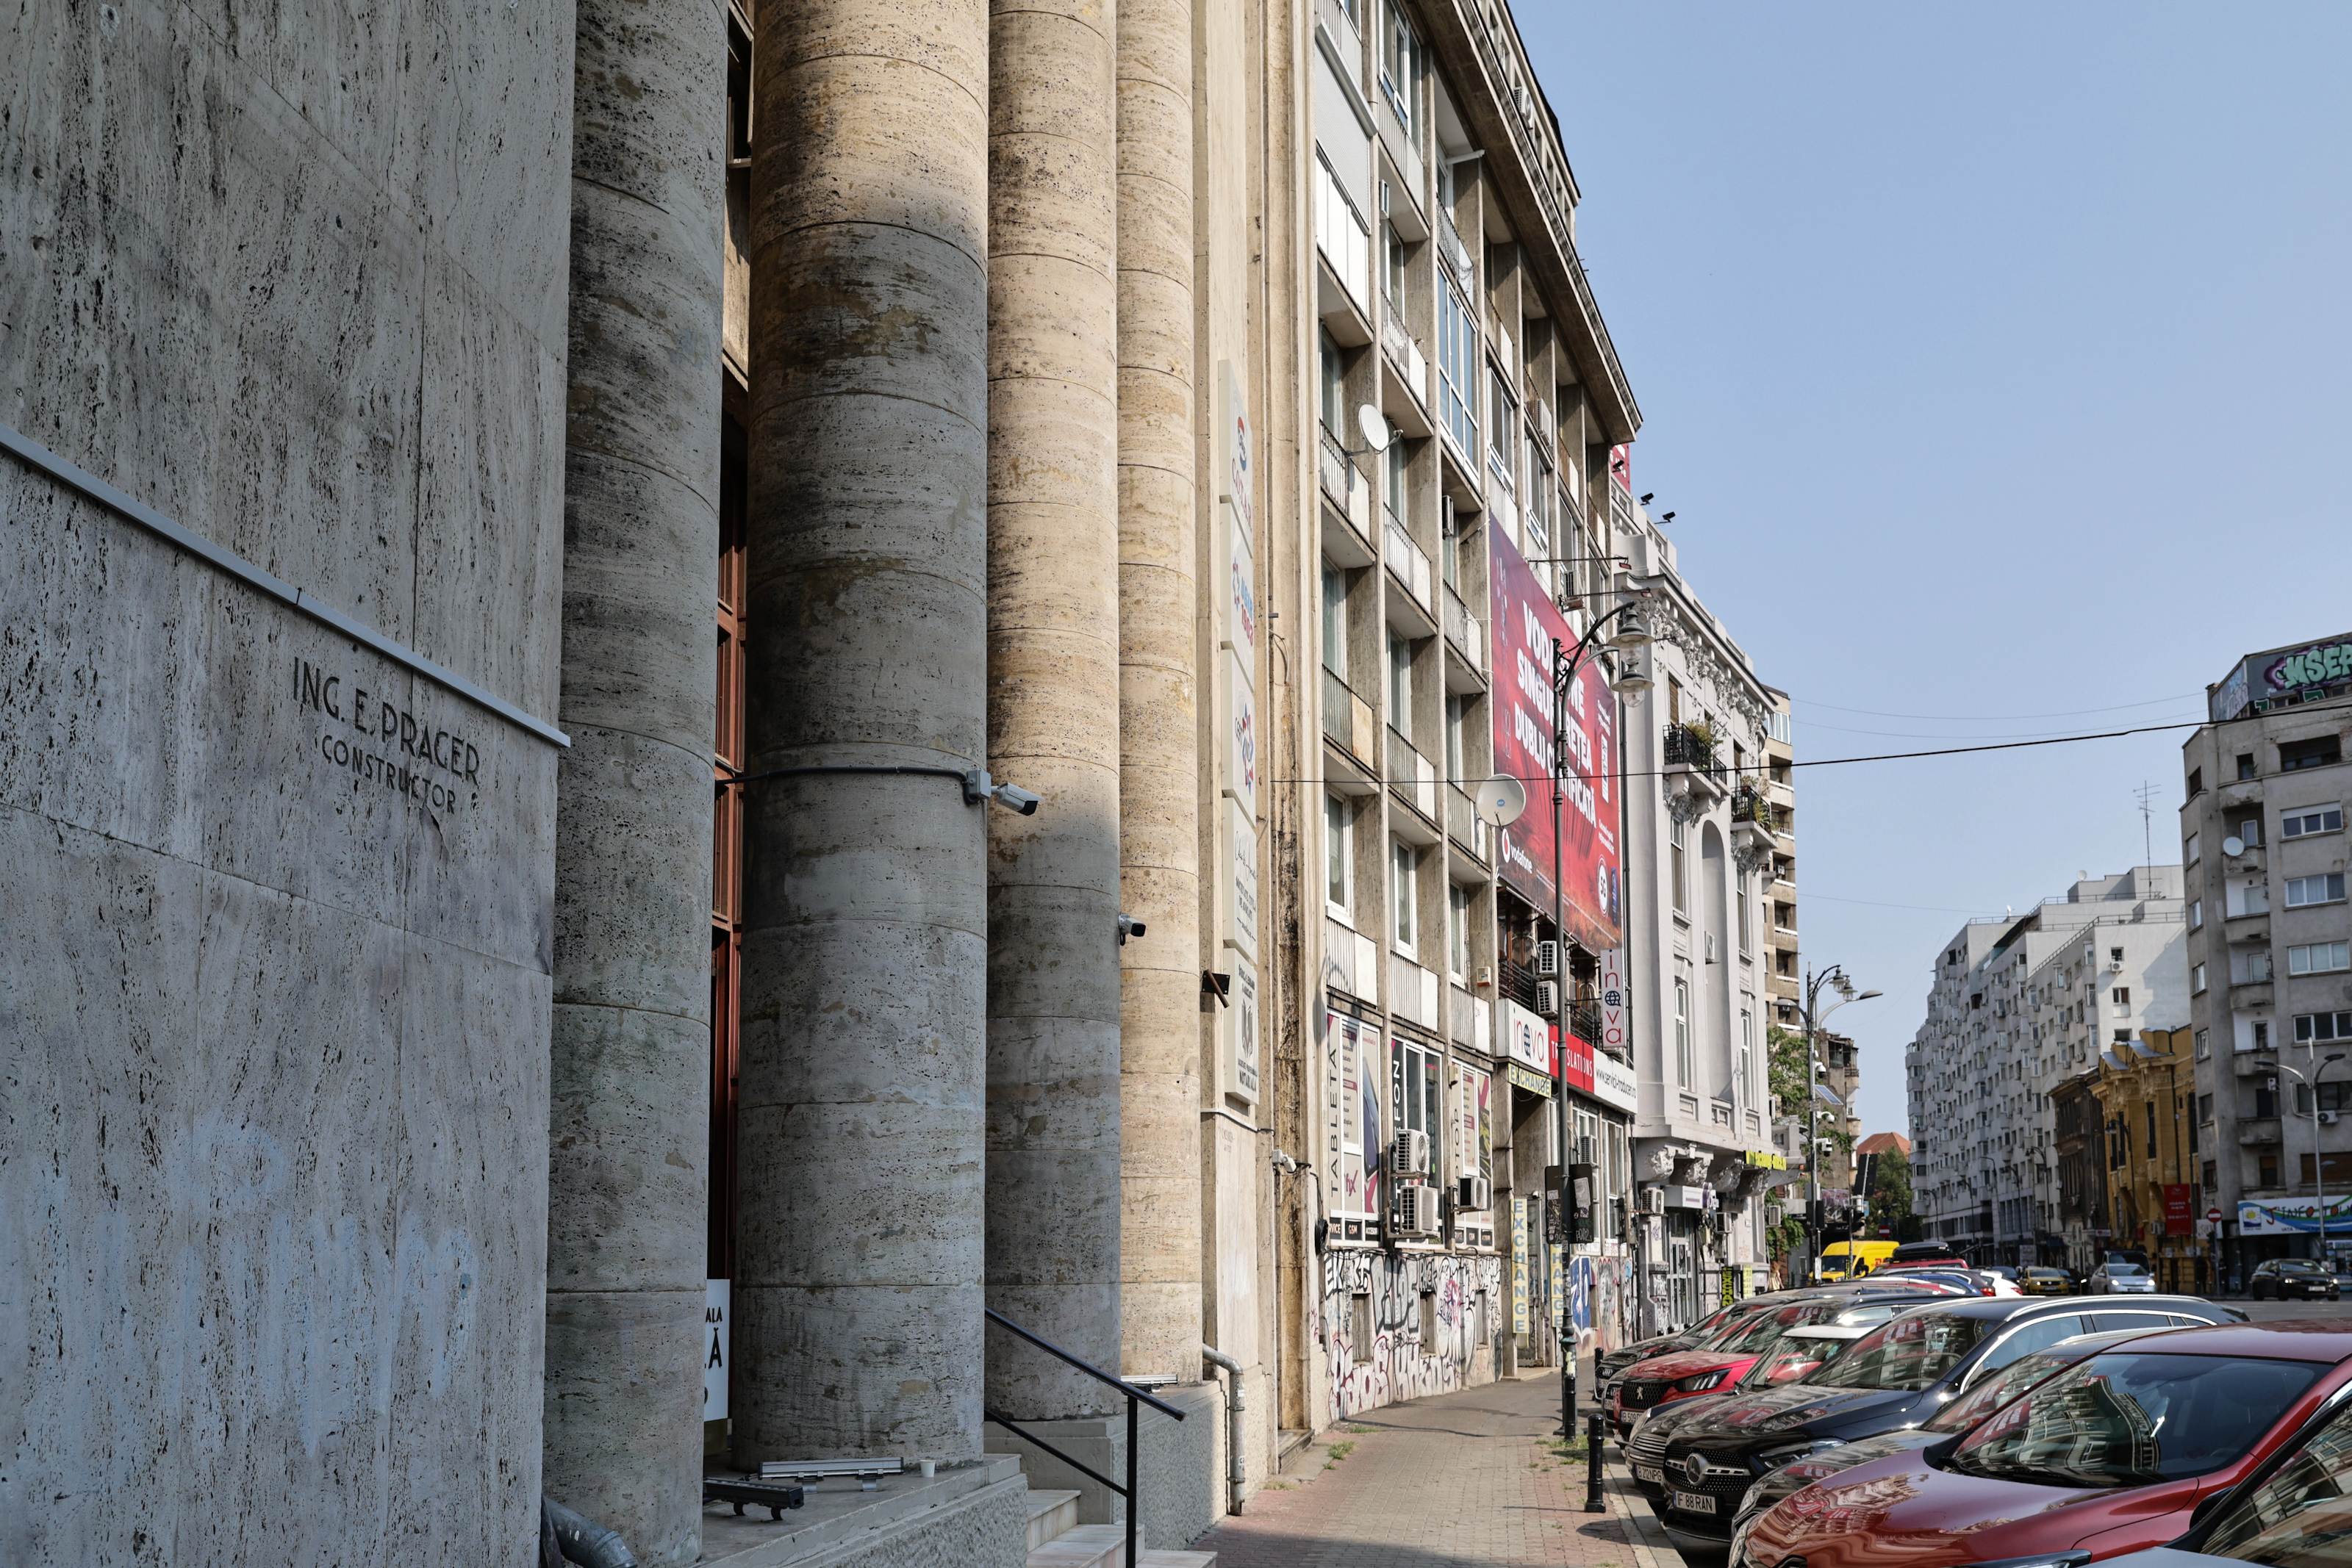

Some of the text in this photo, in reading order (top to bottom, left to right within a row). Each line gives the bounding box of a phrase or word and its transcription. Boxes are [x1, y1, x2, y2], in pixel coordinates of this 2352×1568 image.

[1241, 604, 1254, 647] 1903
[1522, 600, 1585, 720] VODNE
[293, 656, 345, 723] ING.
[321, 735, 456, 815] CONSTRUCTOR
[1514, 701, 1546, 770] DUBLU
[1546, 743, 1597, 829] CTIFICATĂ
[1510, 844, 1533, 874] vodafone
[1551, 1040, 1593, 1077] TRSLATIONS
[1510, 1065, 1550, 1096] EXCHANGE
[1330, 1049, 1338, 1198] TABLETA
[1330, 1223, 1341, 1234] RVICE
[1348, 1225, 1358, 1235] GSM
[1513, 1201, 1527, 1332] EXCHANGE
[1552, 1244, 1563, 1327] HANGE
[1721, 1271, 1734, 1307] EXCHAN
[1623, 1412, 1627, 1422] B
[1627, 1412, 1636, 1423] 509
[1638, 1466, 1642, 1478] B
[1649, 1469, 1662, 1481] NPG
[1677, 1492, 1713, 1511] IF 88 RAN
